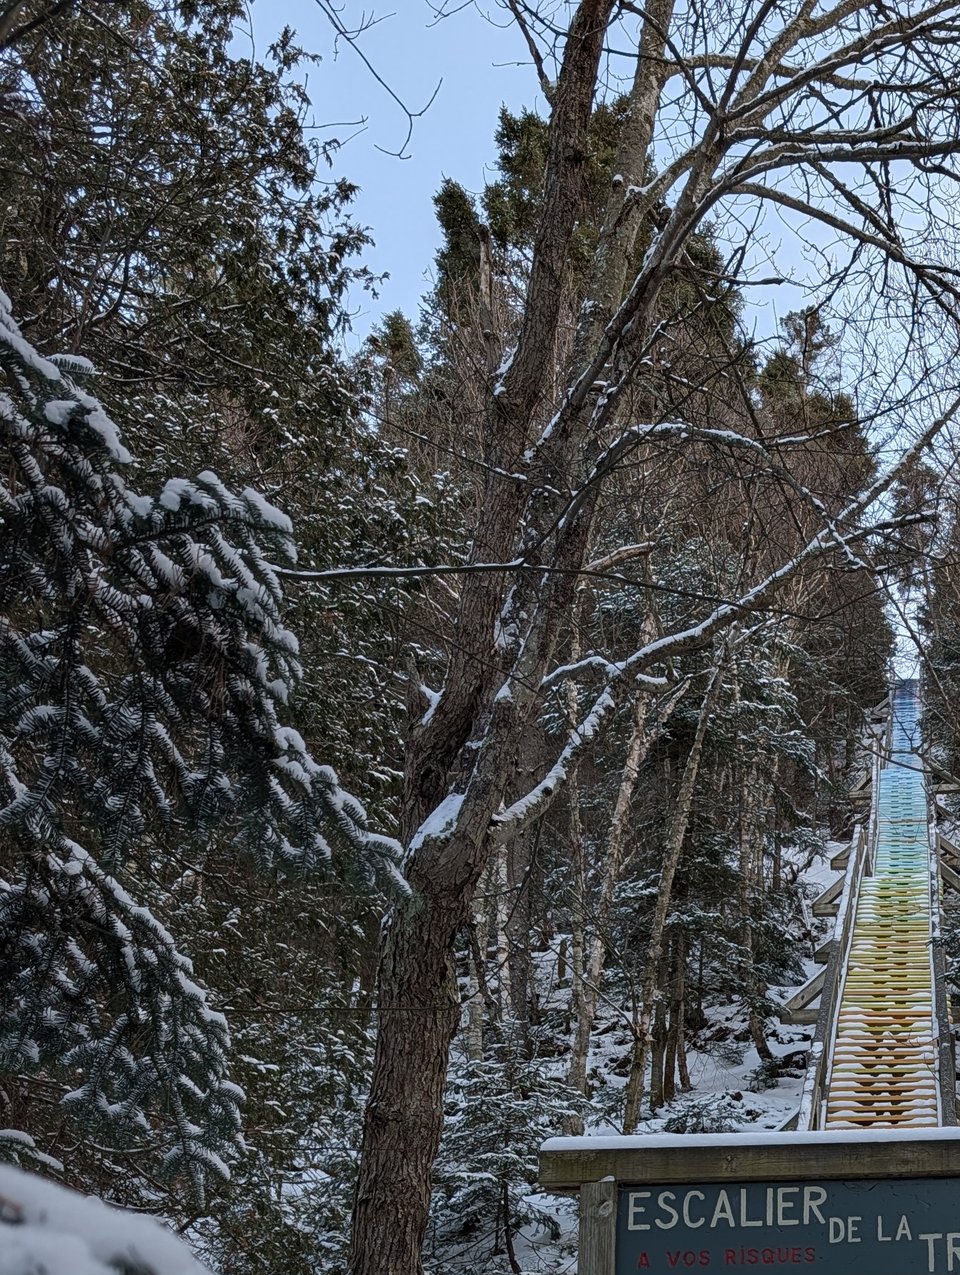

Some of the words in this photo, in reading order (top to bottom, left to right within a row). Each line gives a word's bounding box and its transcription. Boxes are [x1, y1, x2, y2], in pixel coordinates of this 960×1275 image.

[627, 1185, 827, 1231] ESCALIER
[829, 1215, 862, 1244] DE
[877, 1214, 912, 1242] LA
[638, 1251, 651, 1269] A
[667, 1249, 710, 1268] VOS
